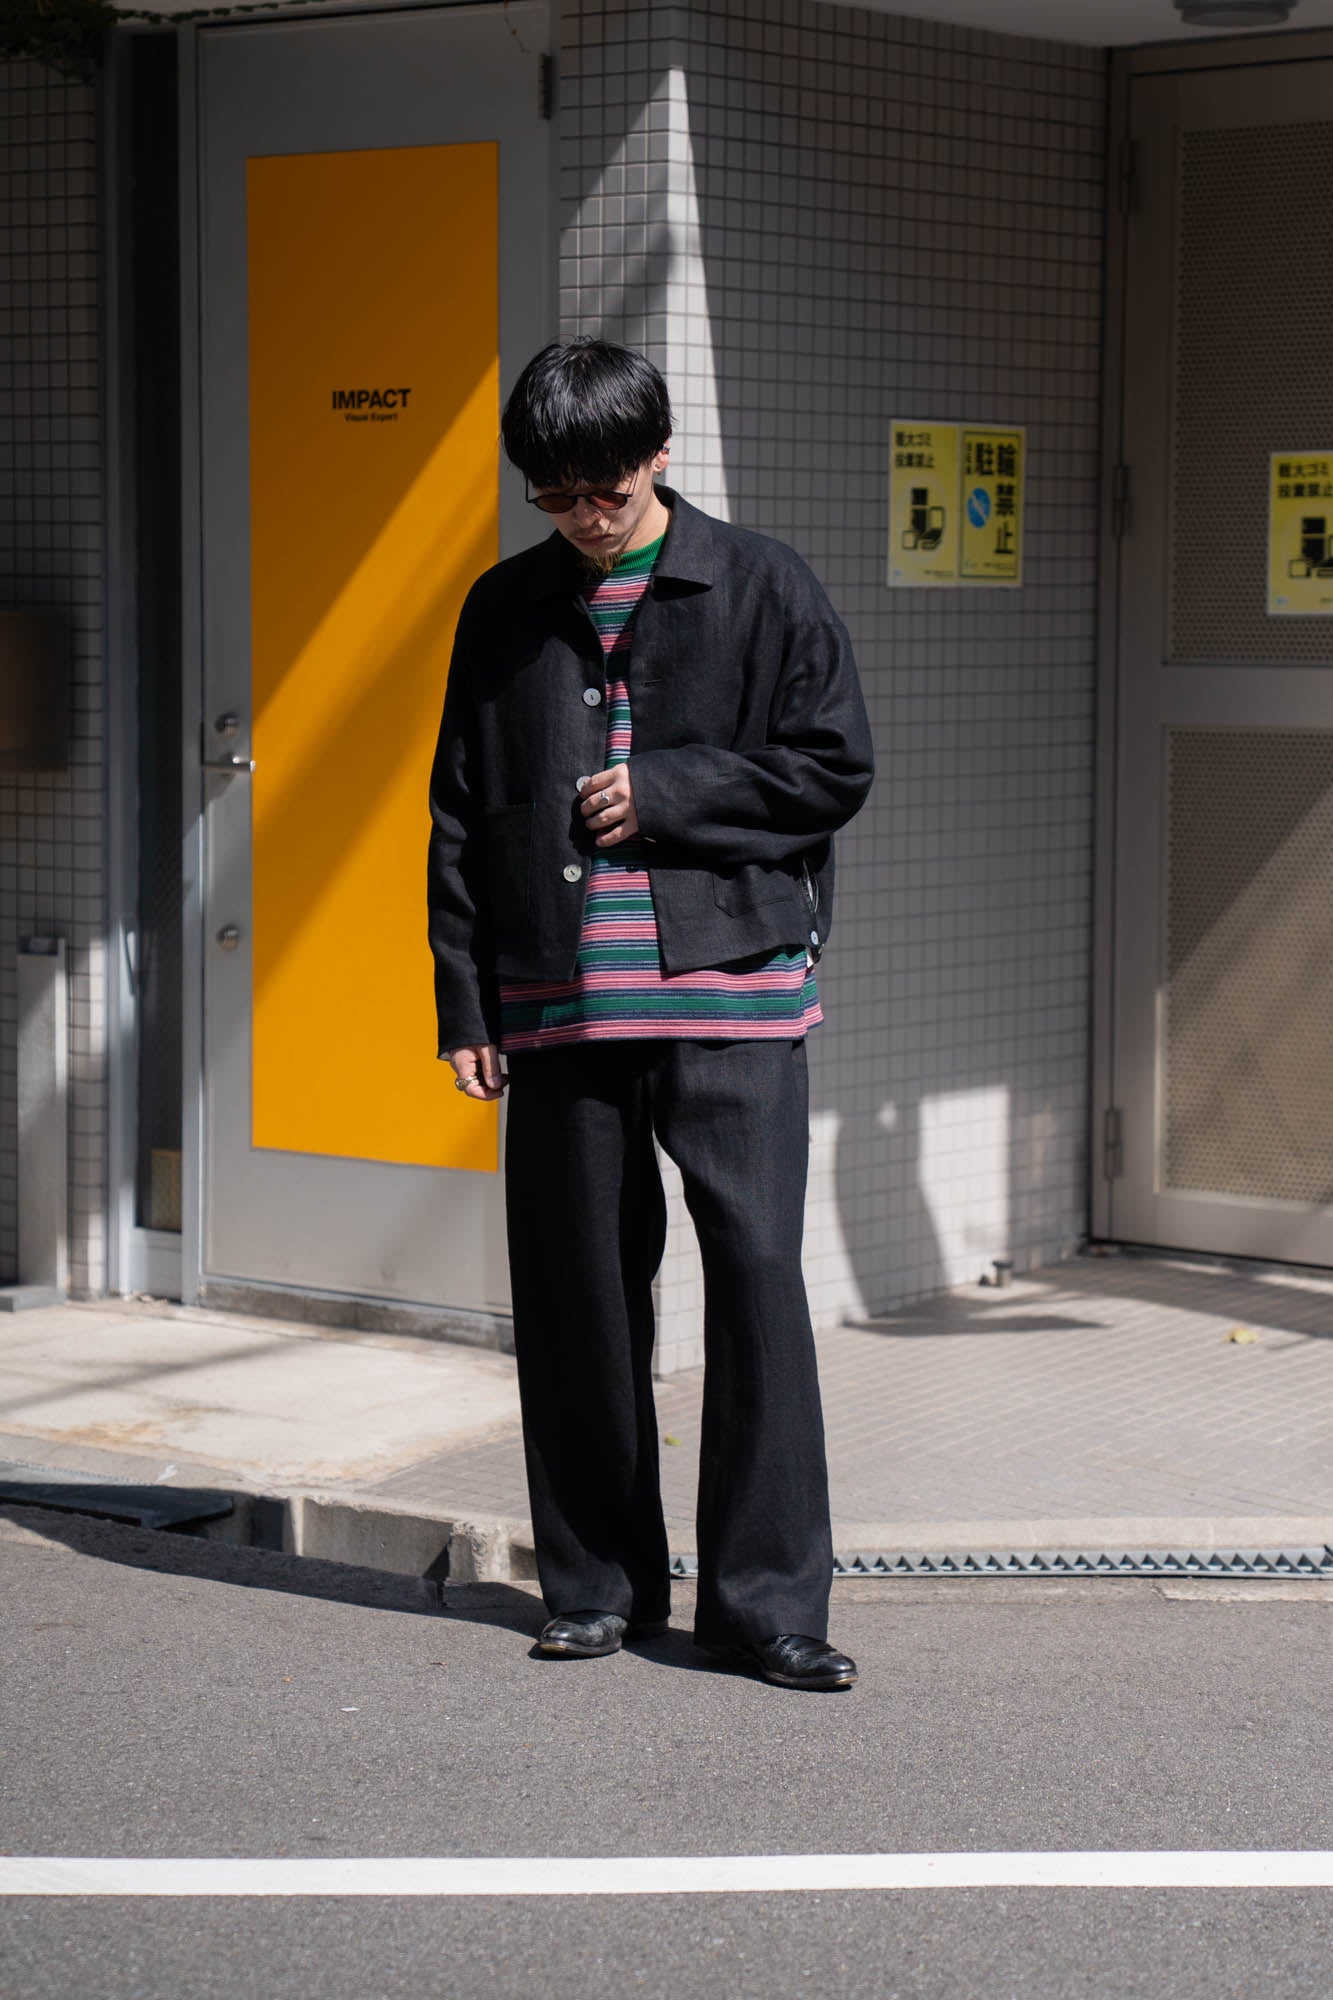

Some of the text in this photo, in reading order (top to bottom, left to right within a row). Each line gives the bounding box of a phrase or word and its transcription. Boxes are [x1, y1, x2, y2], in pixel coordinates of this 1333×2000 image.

[332, 388, 411, 409] IMPACT
[345, 412, 398, 423] Visual Expert
